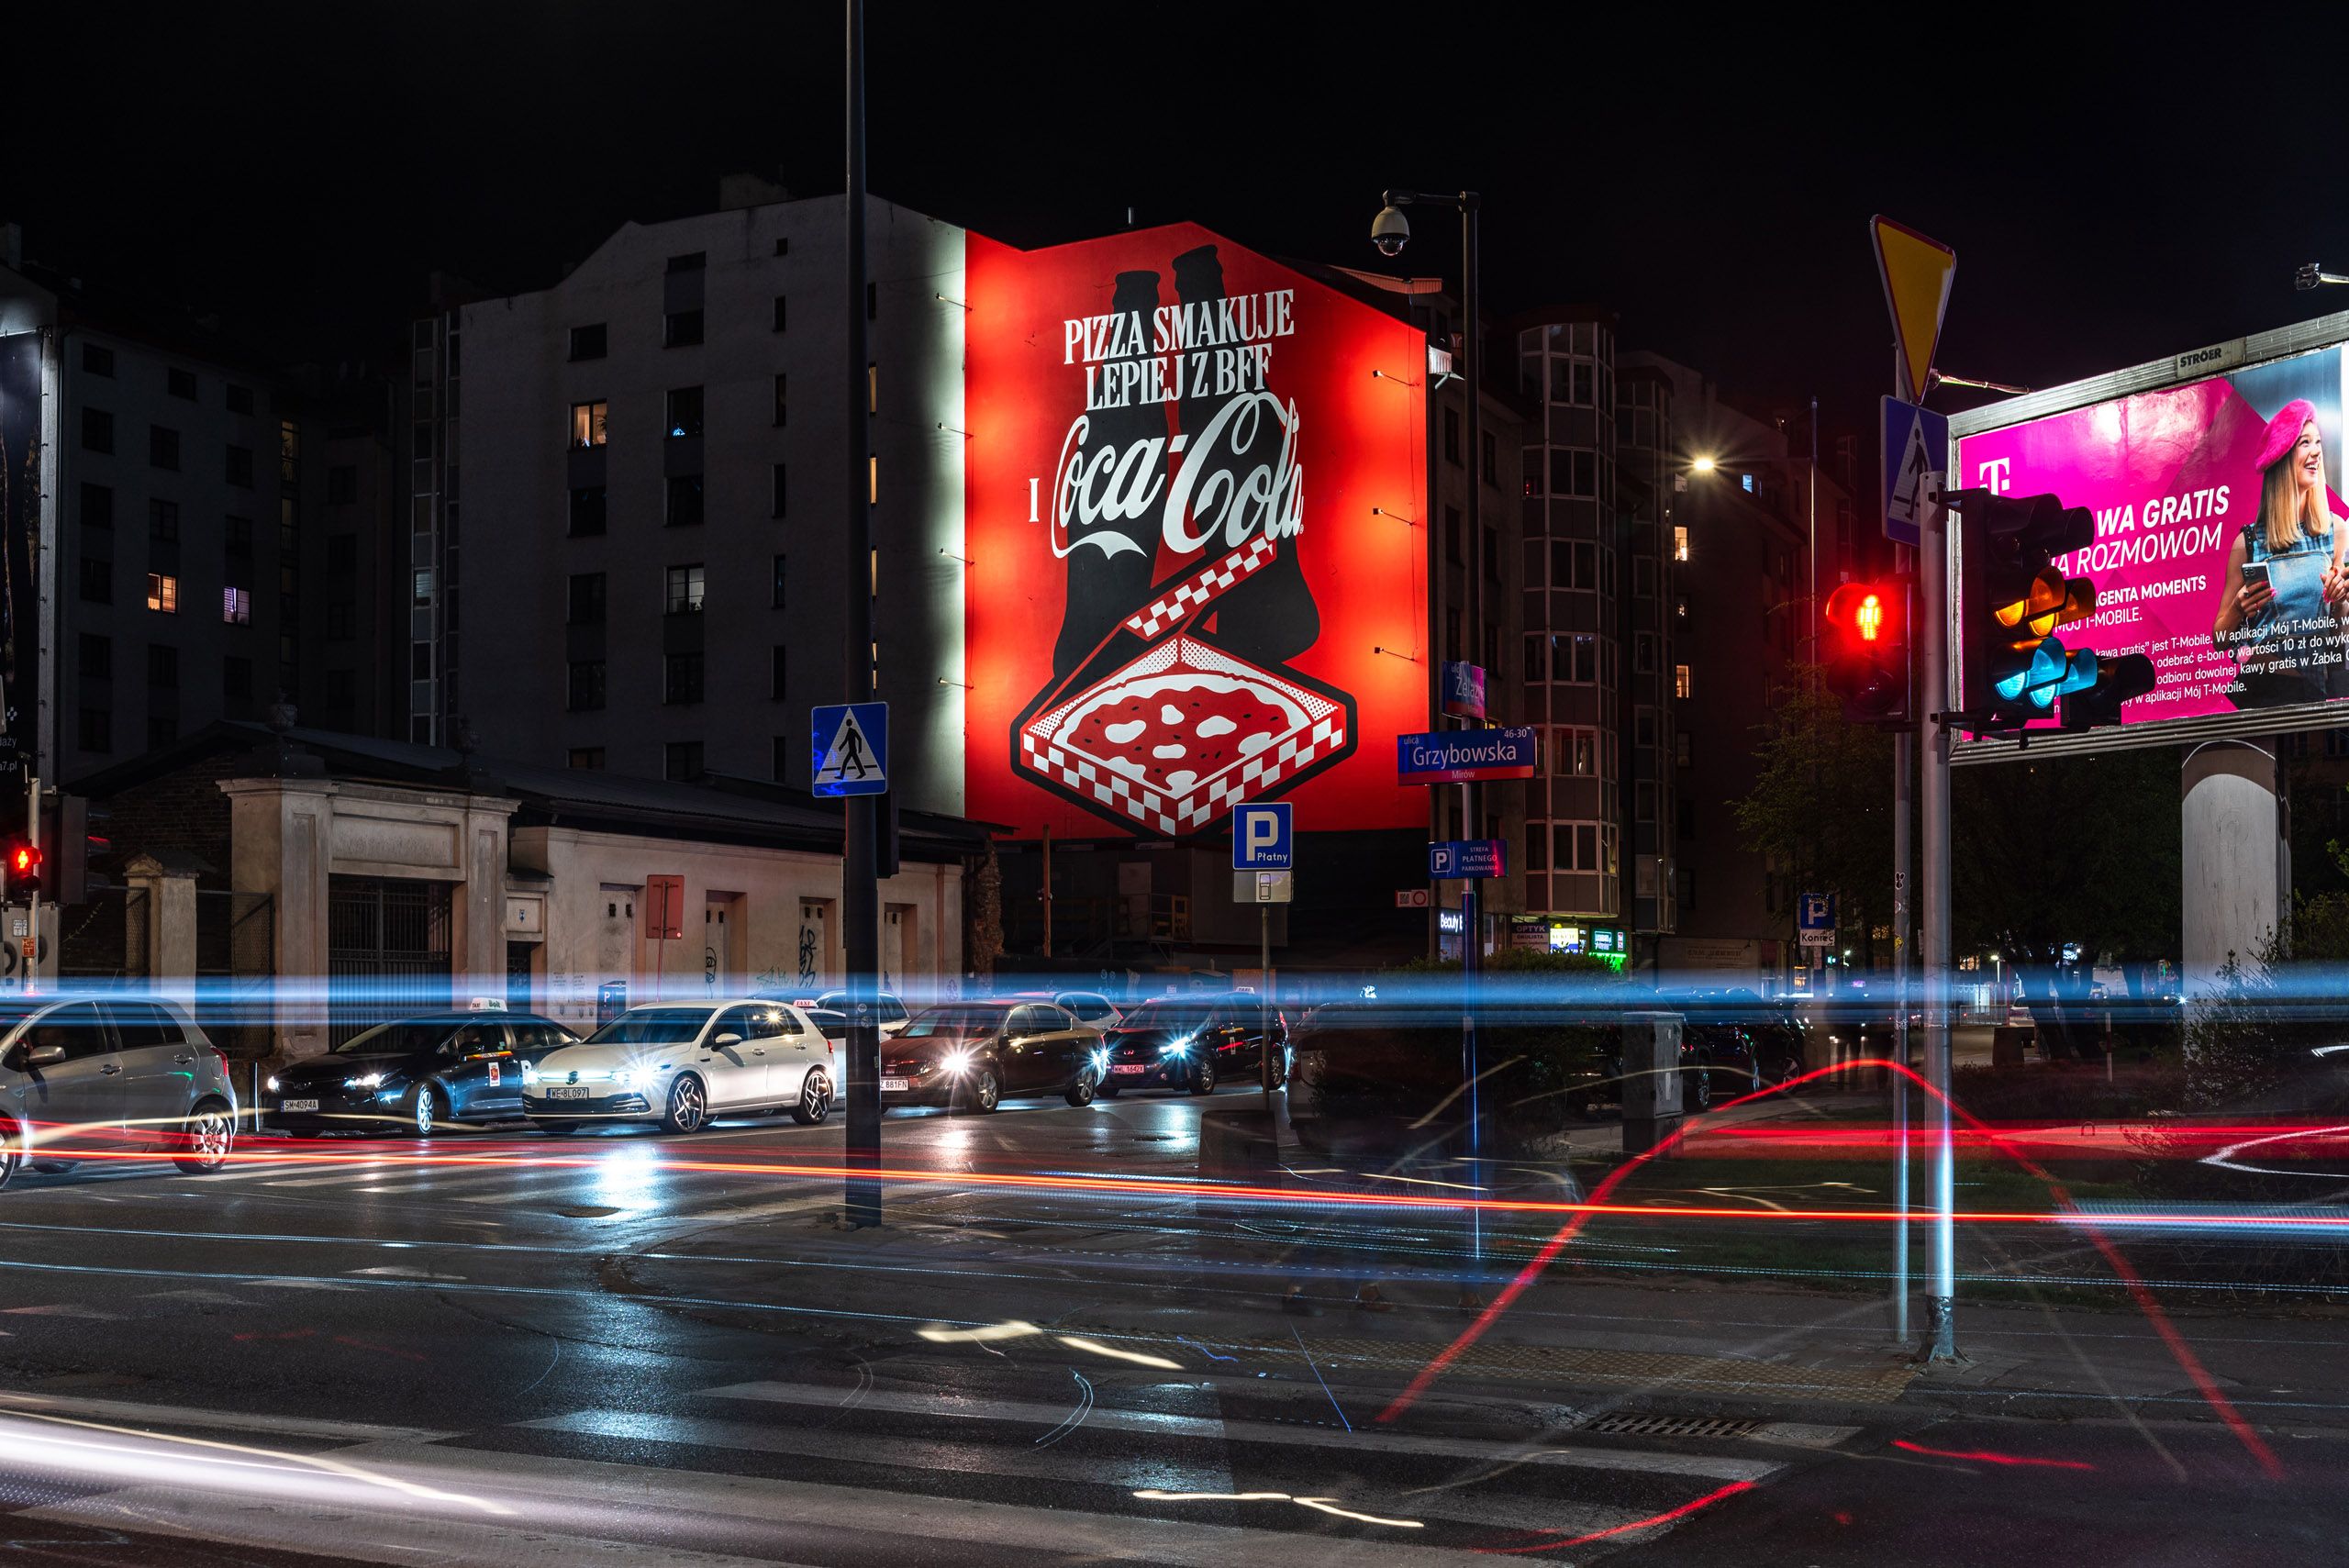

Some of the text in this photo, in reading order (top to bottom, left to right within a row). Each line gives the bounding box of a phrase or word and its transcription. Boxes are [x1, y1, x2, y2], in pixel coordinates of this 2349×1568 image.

[1063, 289, 1295, 365] PIZZA SMAKUJE
[1085, 343, 1273, 411] LEPIEJ Z BFF
[1029, 391, 1304, 560] I Coca-Cola
[2143, 484, 2231, 529] GRATIS
[2076, 521, 2222, 574] ROZMOWOM
[2141, 574, 2207, 600] MOMENTS
[2086, 606, 2143, 628] T-MOBILE.
[2151, 640, 2168, 653] jest
[2171, 633, 2213, 650] T-Mobile.
[2215, 630, 2227, 642] W
[2230, 624, 2268, 642] aplikacji
[2270, 621, 2289, 636] Mój
[2291, 617, 2339, 632] T-Mobile,
[2156, 652, 2194, 668] odebrać
[2197, 650, 2224, 663] e-bon
[2228, 650, 2234, 659] o
[2237, 642, 2279, 657] wartości
[2282, 638, 2295, 651] 10
[2298, 637, 2307, 650] zł
[2310, 635, 2322, 647] do
[2156, 671, 2192, 685] odbioru
[2195, 662, 2237, 679] dowolnej
[2240, 662, 2266, 675] kawy
[2268, 656, 2297, 673] gratis
[2299, 656, 2310, 666] w
[2312, 650, 2343, 665] Żabka
[2145, 687, 2182, 704] aplikacji
[2184, 685, 2201, 699] Mój
[2203, 681, 2247, 696] T-Mobile.
[1403, 736, 1419, 745] ulica
[1504, 728, 1527, 739] 46-30
[1412, 740, 1517, 770] Grzybowska
[1452, 770, 1475, 779] Mirów
[1246, 811, 1279, 862] P
[1257, 852, 1288, 863] Płatny
[1435, 851, 1447, 870] P
[1462, 854, 1497, 862] PŁATNEGO
[1440, 912, 1459, 933] Beauty
[1808, 898, 1829, 925] P
[1801, 933, 1833, 942] Koniec
